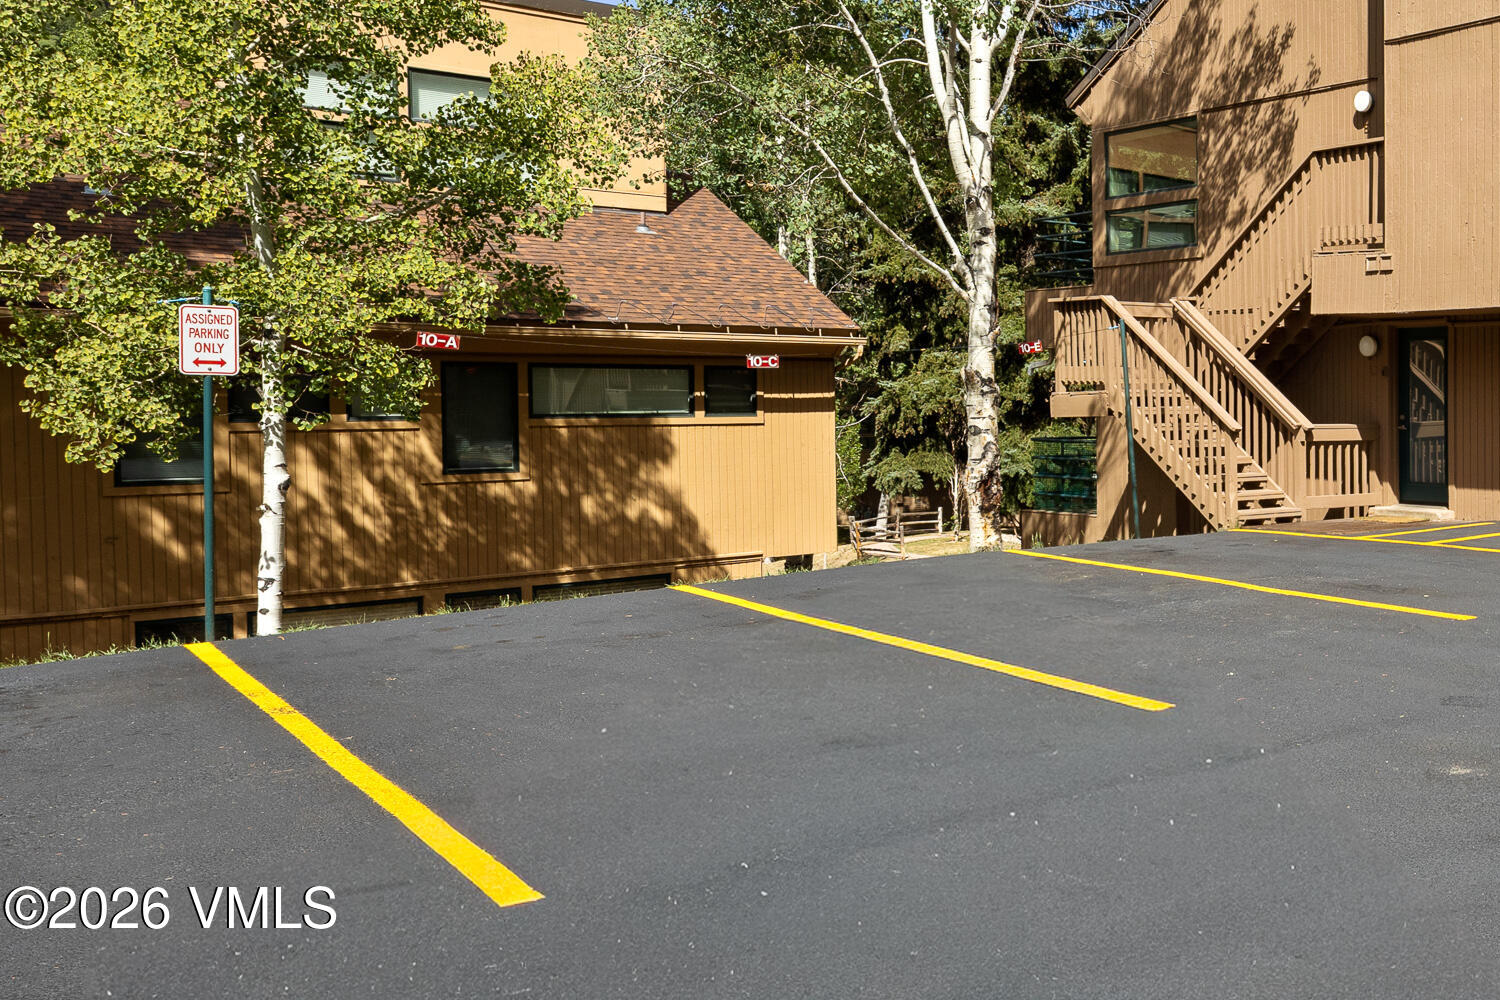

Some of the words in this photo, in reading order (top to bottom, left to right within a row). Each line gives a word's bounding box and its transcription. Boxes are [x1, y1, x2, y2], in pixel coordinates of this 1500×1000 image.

[185, 313, 233, 325] ASSIGNED
[188, 327, 229, 339] PARKING
[419, 333, 457, 348] 10-A
[194, 342, 225, 353] ONLY
[1020, 342, 1041, 353] 10-E
[749, 356, 778, 367] 10-C
